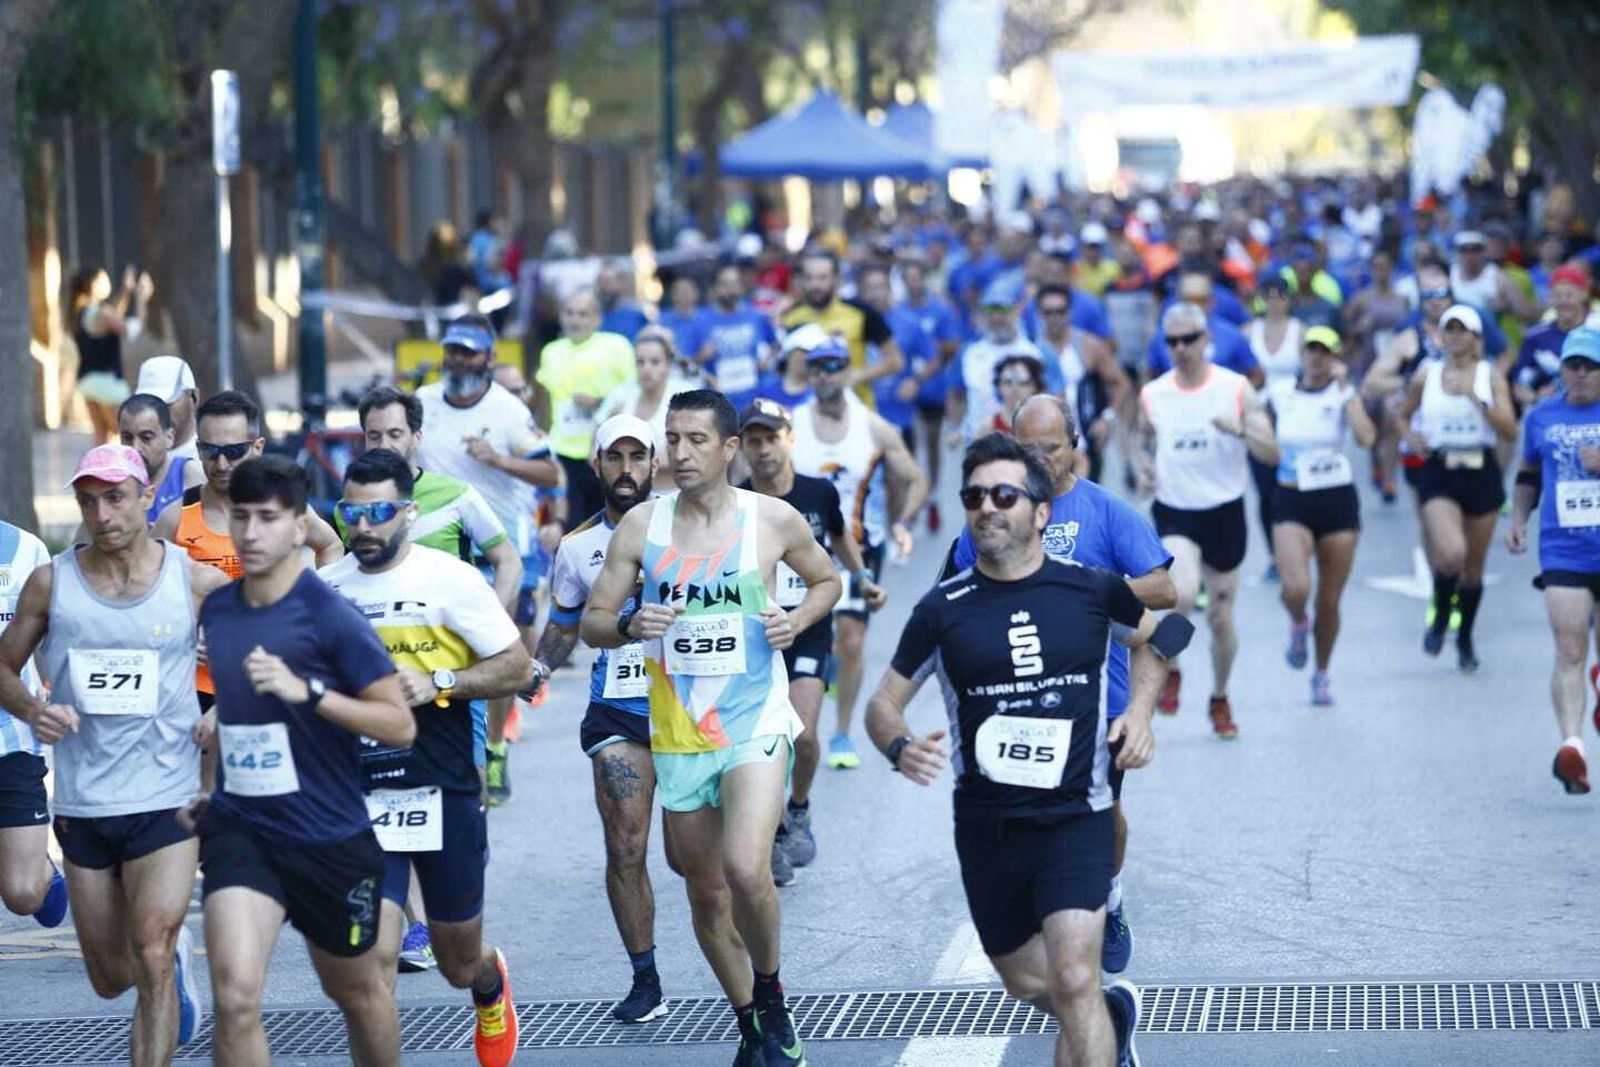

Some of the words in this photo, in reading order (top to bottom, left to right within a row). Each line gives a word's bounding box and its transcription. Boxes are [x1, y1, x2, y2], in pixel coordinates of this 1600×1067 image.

[659, 581, 742, 608] BERLIN
[673, 636, 737, 655] 638
[87, 673, 142, 690] 571
[997, 742, 1055, 763] 185
[371, 810, 428, 828] 418
